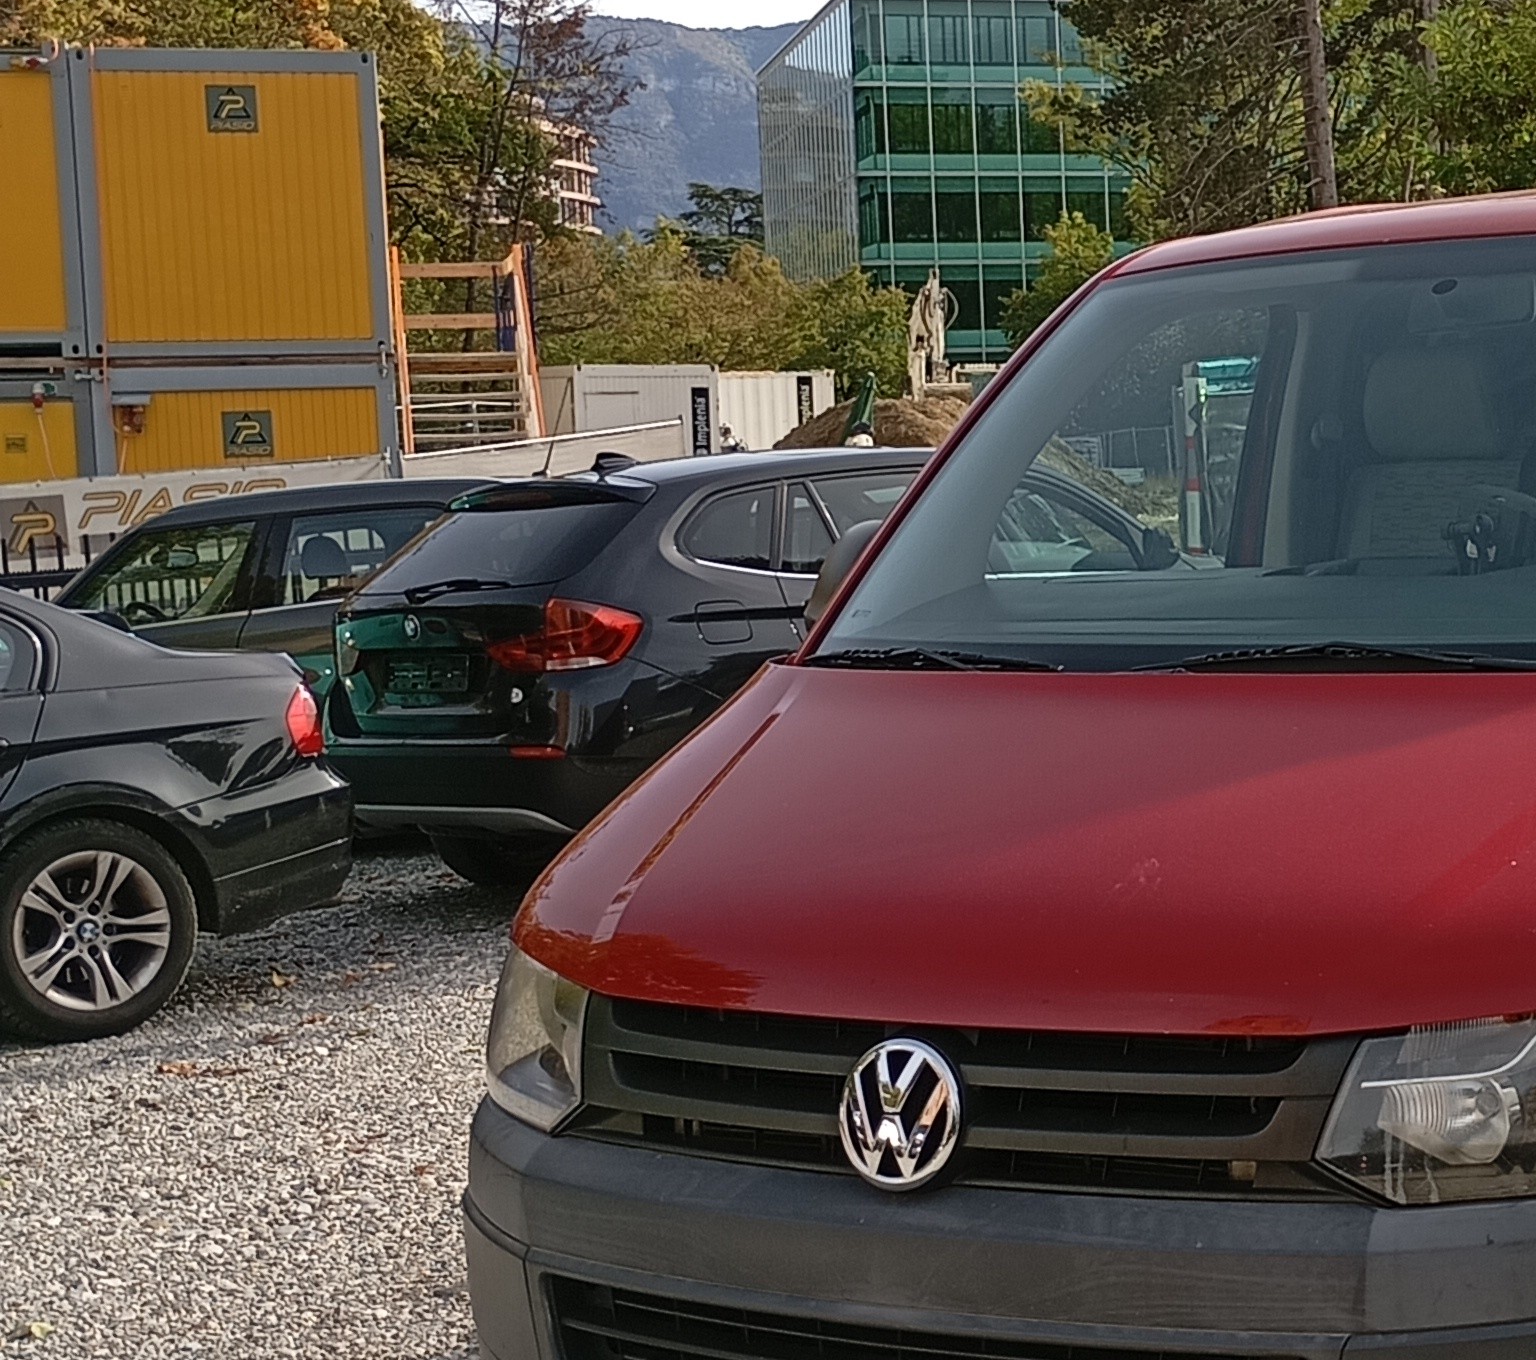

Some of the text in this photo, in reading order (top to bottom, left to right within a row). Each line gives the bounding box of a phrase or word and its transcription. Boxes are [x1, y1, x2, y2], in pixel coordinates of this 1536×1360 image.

[695, 397, 709, 446] Implenia
[800, 384, 813, 425] plenia
[78, 477, 287, 529] PIA
